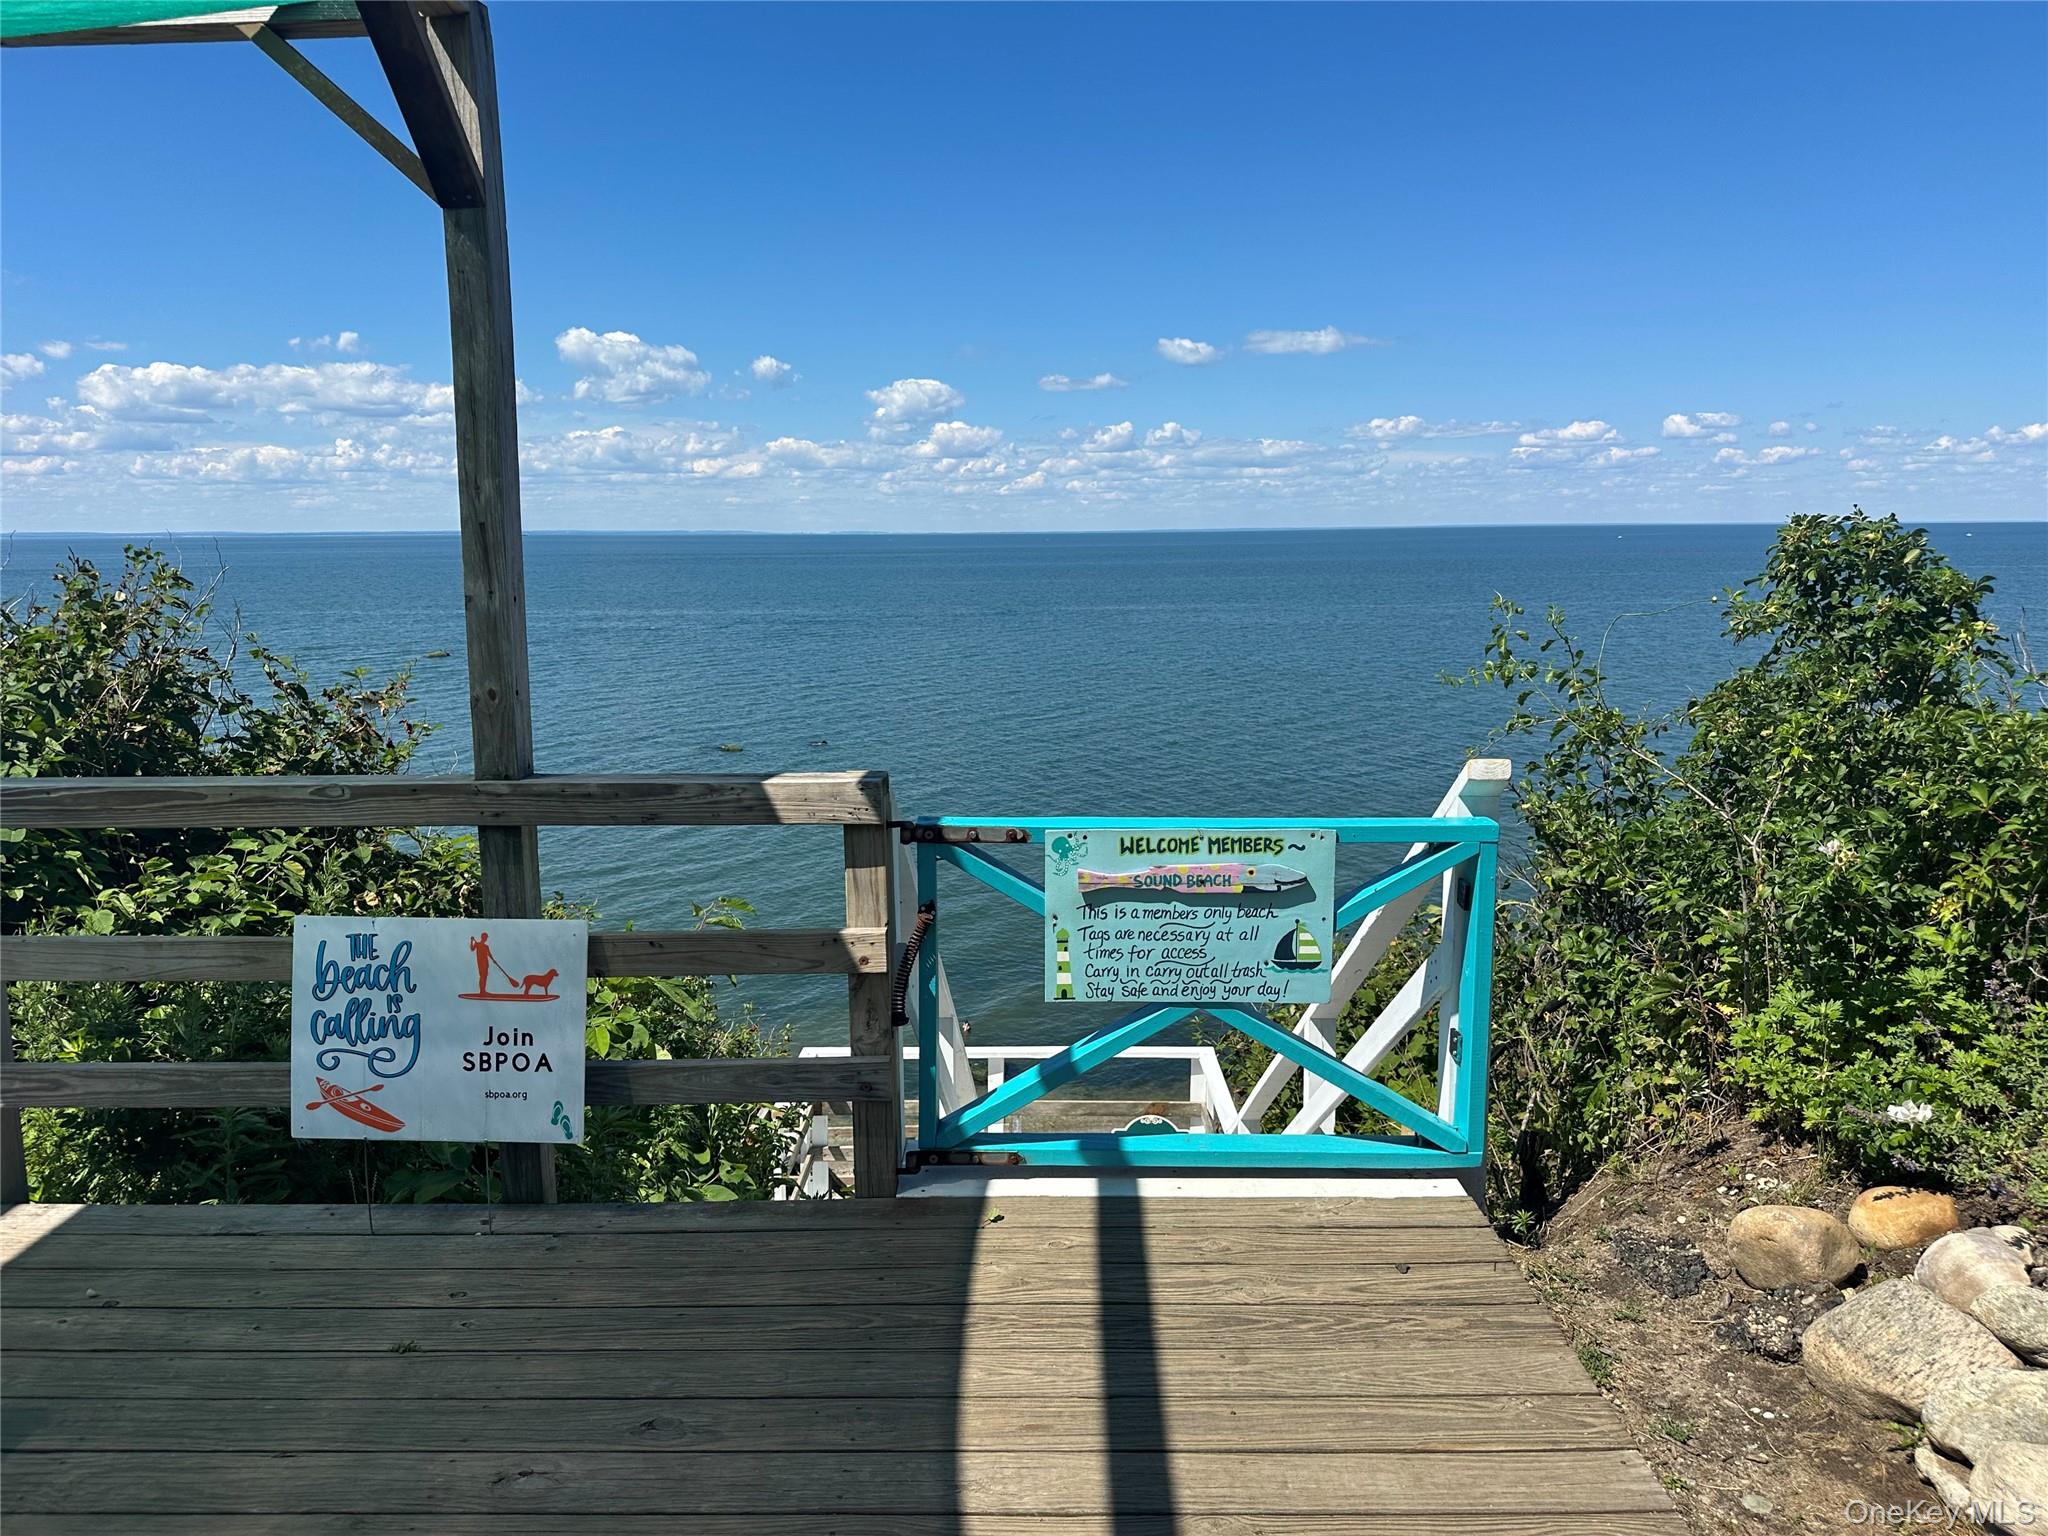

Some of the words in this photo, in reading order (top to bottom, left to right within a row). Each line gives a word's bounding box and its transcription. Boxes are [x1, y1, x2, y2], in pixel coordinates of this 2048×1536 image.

[1120, 836, 1200, 855] WELCOME
[1208, 836, 1284, 855] MEMBERS
[1133, 874, 1182, 888] SOUND
[1186, 874, 1232, 887] BEACH
[1077, 904, 1108, 920] This
[1114, 906, 1126, 919] is
[1130, 908, 1140, 919] a
[1142, 906, 1198, 920] members
[1204, 906, 1232, 924] only
[1238, 904, 1278, 919] beach
[1077, 927, 1110, 946] Tags
[1115, 928, 1134, 940] are
[1138, 929, 1210, 947] necessary
[1216, 928, 1234, 941] at
[1239, 926, 1258, 940] all
[346, 933, 379, 962] THE
[1084, 944, 1124, 960] times
[1128, 945, 1154, 962] for
[1162, 947, 1206, 959] access
[312, 940, 416, 1002] beach
[1085, 964, 1120, 982] Carry
[1127, 966, 1140, 978] in
[1232, 961, 1266, 978] trash
[1086, 982, 1114, 1002] Stay
[1152, 982, 1178, 996] and
[1182, 982, 1216, 1000] enjoy
[1224, 985, 1254, 1001] your
[1258, 980, 1288, 1001] day!
[310, 997, 421, 1078] calling
[483, 1026, 534, 1046] Join
[462, 1052, 552, 1072] SBPOA
[484, 1090, 528, 1100] sbpoa.org
